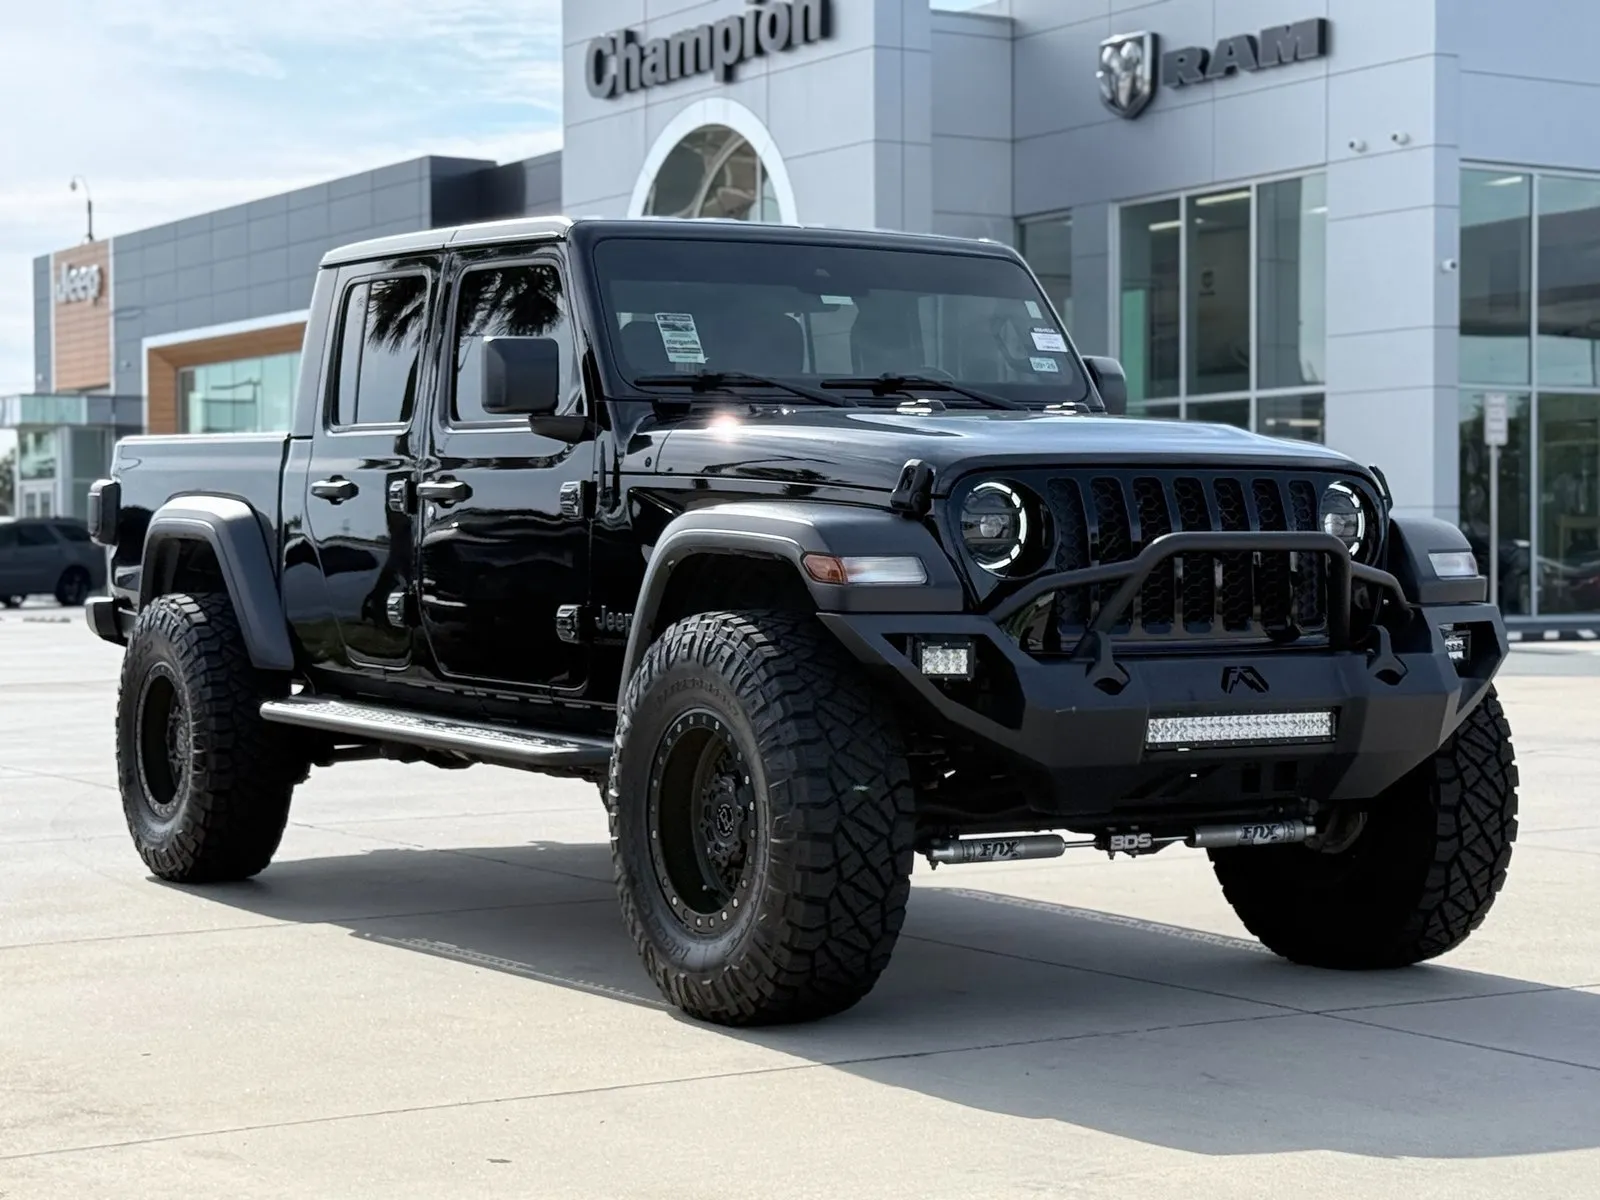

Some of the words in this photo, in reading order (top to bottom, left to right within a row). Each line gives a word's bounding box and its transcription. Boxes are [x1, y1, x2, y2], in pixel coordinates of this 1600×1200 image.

[585, 0, 831, 98] Champion
[1162, 17, 1328, 88] RAM
[56, 262, 102, 306] Jeep
[1111, 833, 1152, 849] BDS
